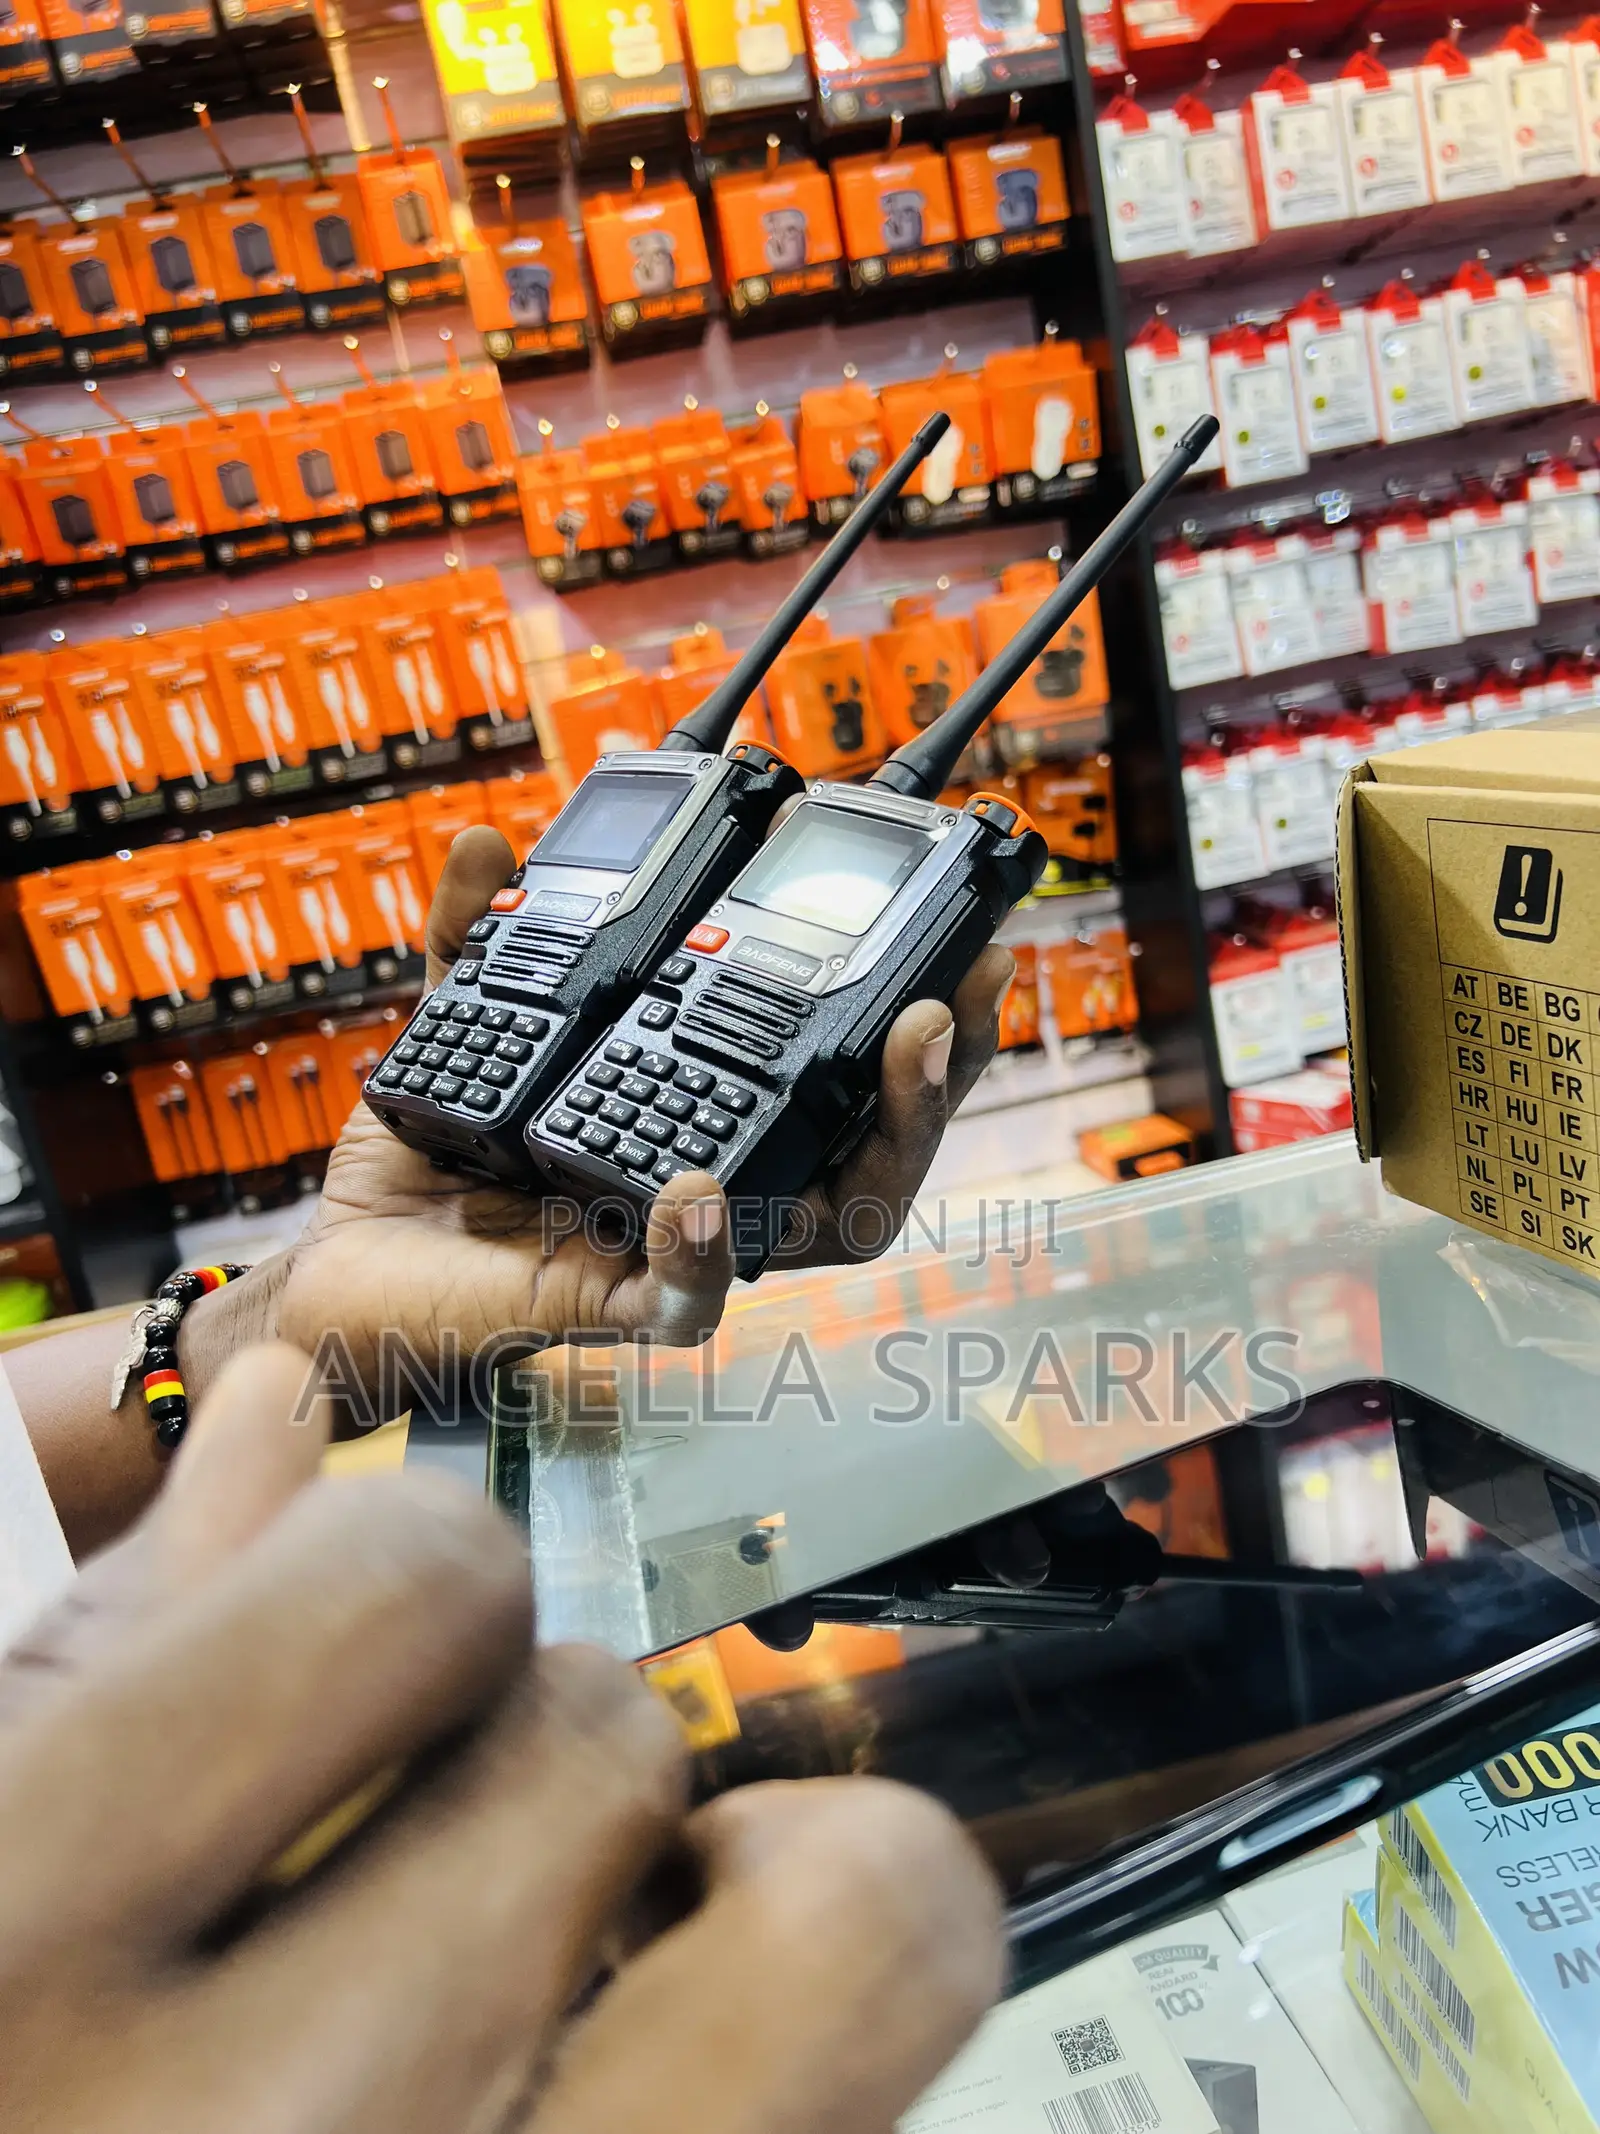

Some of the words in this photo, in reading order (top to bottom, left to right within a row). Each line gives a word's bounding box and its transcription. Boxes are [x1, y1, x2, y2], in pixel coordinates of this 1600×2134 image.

[469, 922, 489, 934] A/B
[693, 928, 718, 944] V/M
[661, 960, 686, 975] A/B
[737, 945, 815, 977] BAOFENG
[1453, 973, 1478, 999] AT
[1498, 981, 1529, 1011] BE
[1545, 992, 1581, 1022] BG
[515, 1016, 533, 1025] EXIT
[1454, 1011, 1484, 1039] CZ
[1501, 1021, 1532, 1051] DE
[1548, 1032, 1583, 1065] DK
[718, 1084, 739, 1097] EXIT
[1457, 1046, 1486, 1075] ES
[1509, 1060, 1529, 1087] FI
[1551, 1071, 1584, 1103] FR
[668, 1099, 684, 1109] DEF
[1459, 1081, 1490, 1112] HR
[1506, 1095, 1538, 1126] HU
[1559, 1111, 1582, 1141] IE
[1465, 1121, 1488, 1148] LT
[1510, 1135, 1539, 1166] LU
[1559, 1152, 1586, 1181] LV
[1466, 1155, 1495, 1185] NL
[1513, 1171, 1542, 1203] PL
[1560, 1188, 1590, 1219] PT
[1470, 1190, 1498, 1220] SE
[1521, 1209, 1542, 1237] SI
[1562, 1225, 1596, 1259] SK
[1474, 1798, 1579, 1842] BANK
